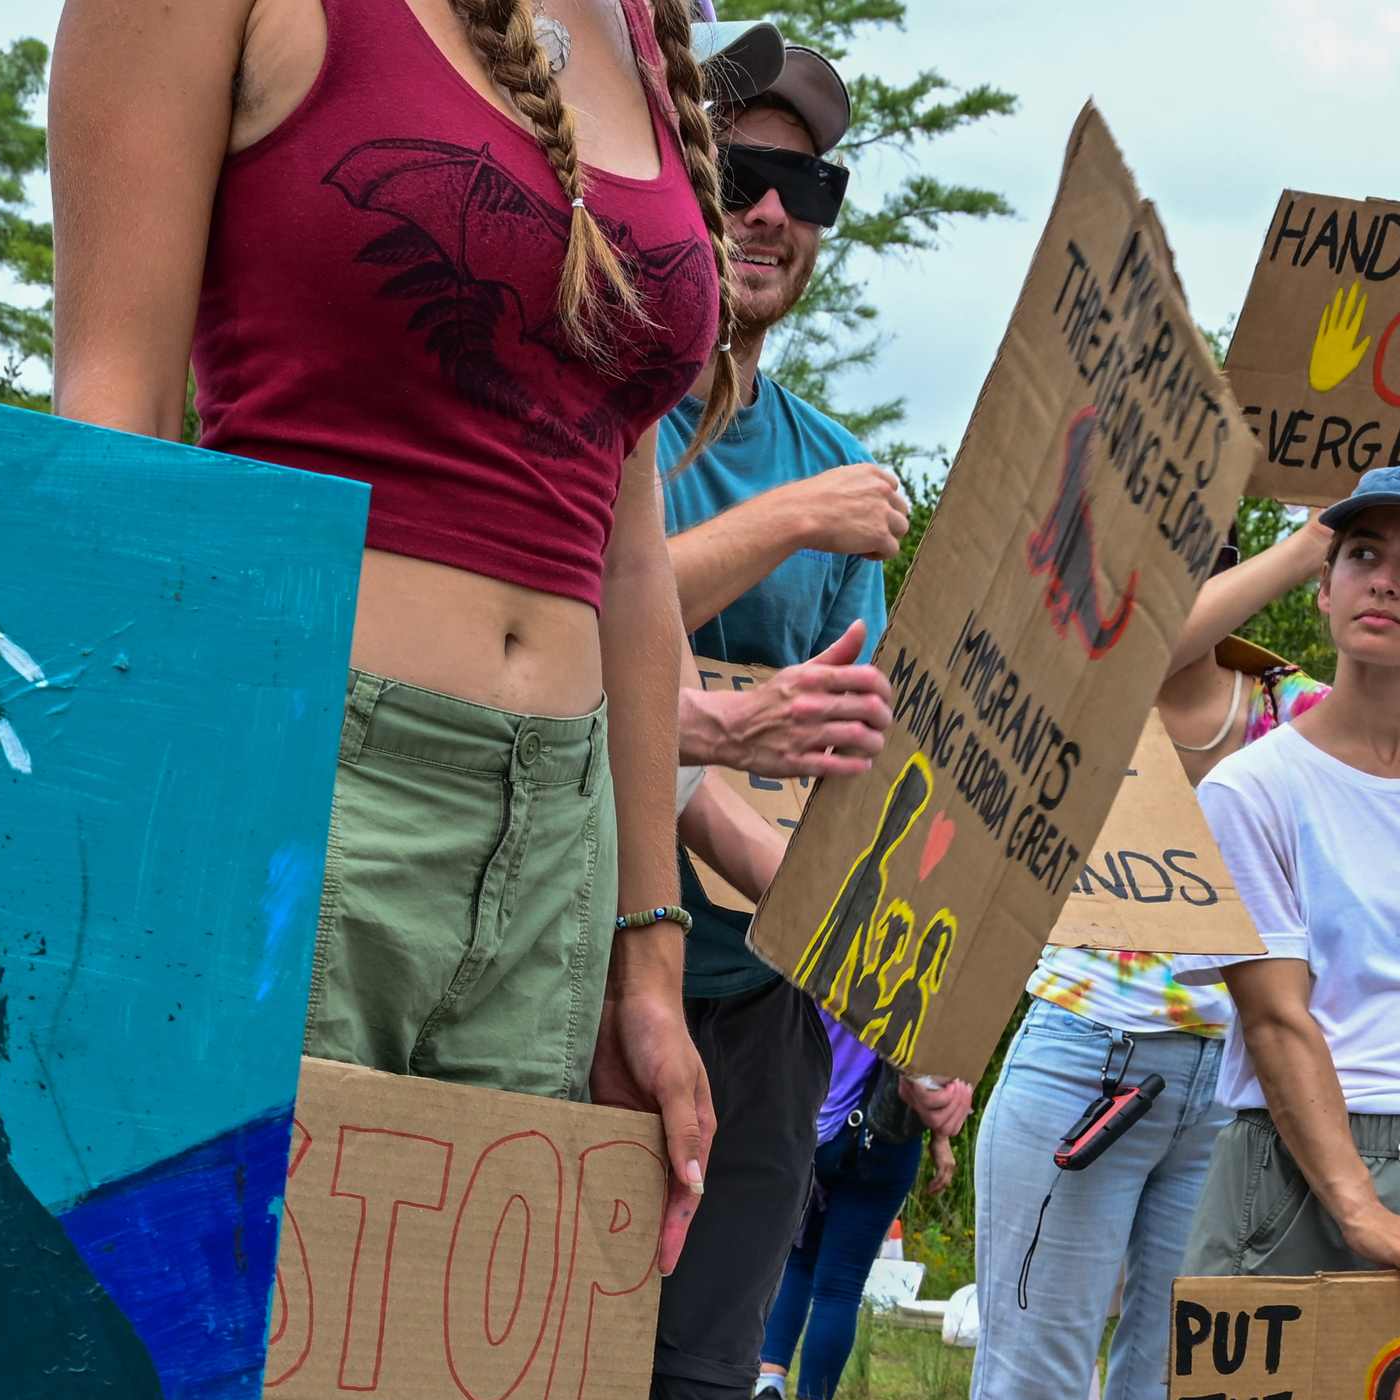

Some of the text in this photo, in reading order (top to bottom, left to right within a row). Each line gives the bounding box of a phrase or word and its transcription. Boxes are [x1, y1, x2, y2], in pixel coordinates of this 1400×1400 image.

[888, 646, 1080, 896] MAKING FLORIDA GREAT
[946, 609, 1082, 811] IMMIGRANTS
[1174, 1299, 1302, 1377] PUT
